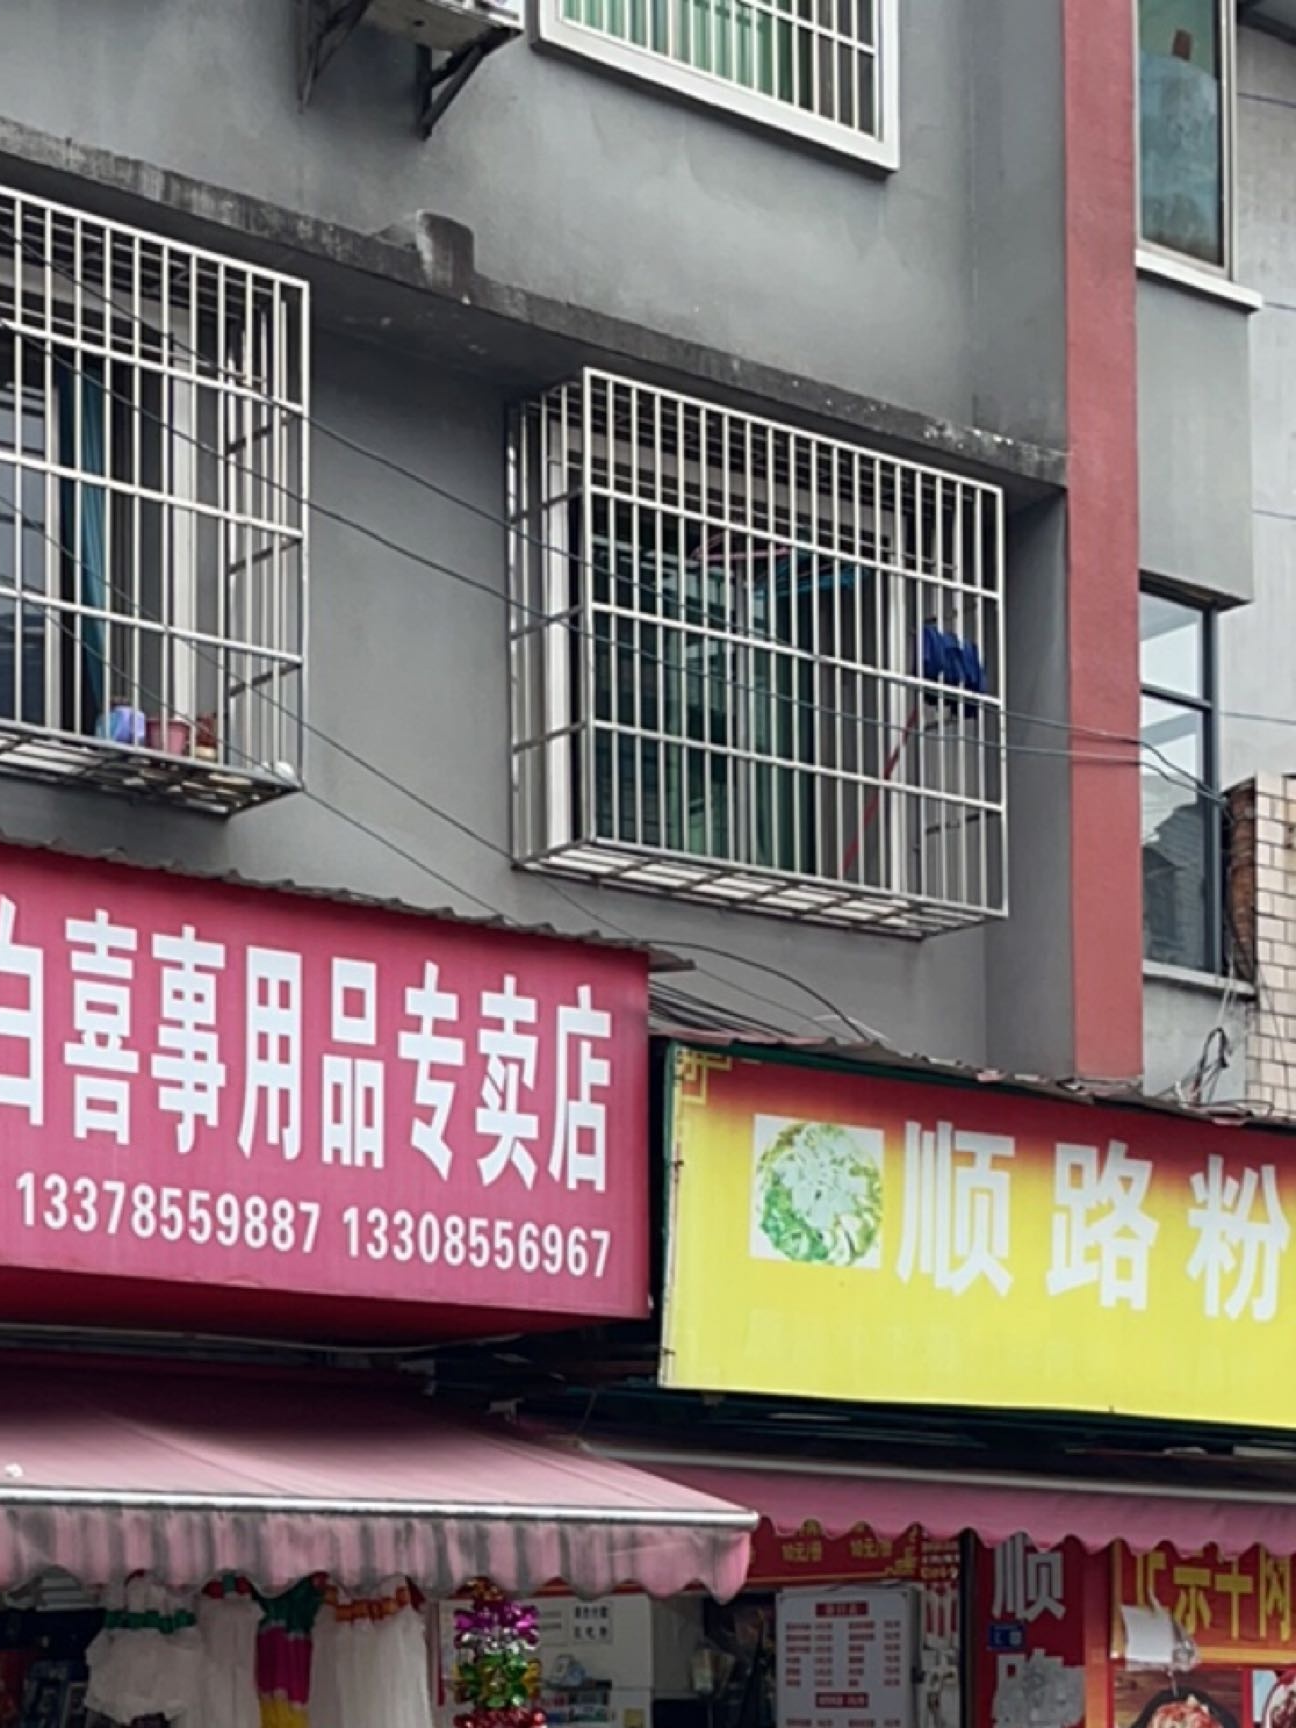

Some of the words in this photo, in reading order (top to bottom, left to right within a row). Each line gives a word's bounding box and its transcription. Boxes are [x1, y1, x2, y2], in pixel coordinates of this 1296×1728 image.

[16, 1171, 321, 1254] 13378559887
[342, 1206, 612, 1278] 13308556967
[897, 1120, 1291, 1322] 顺路粉
